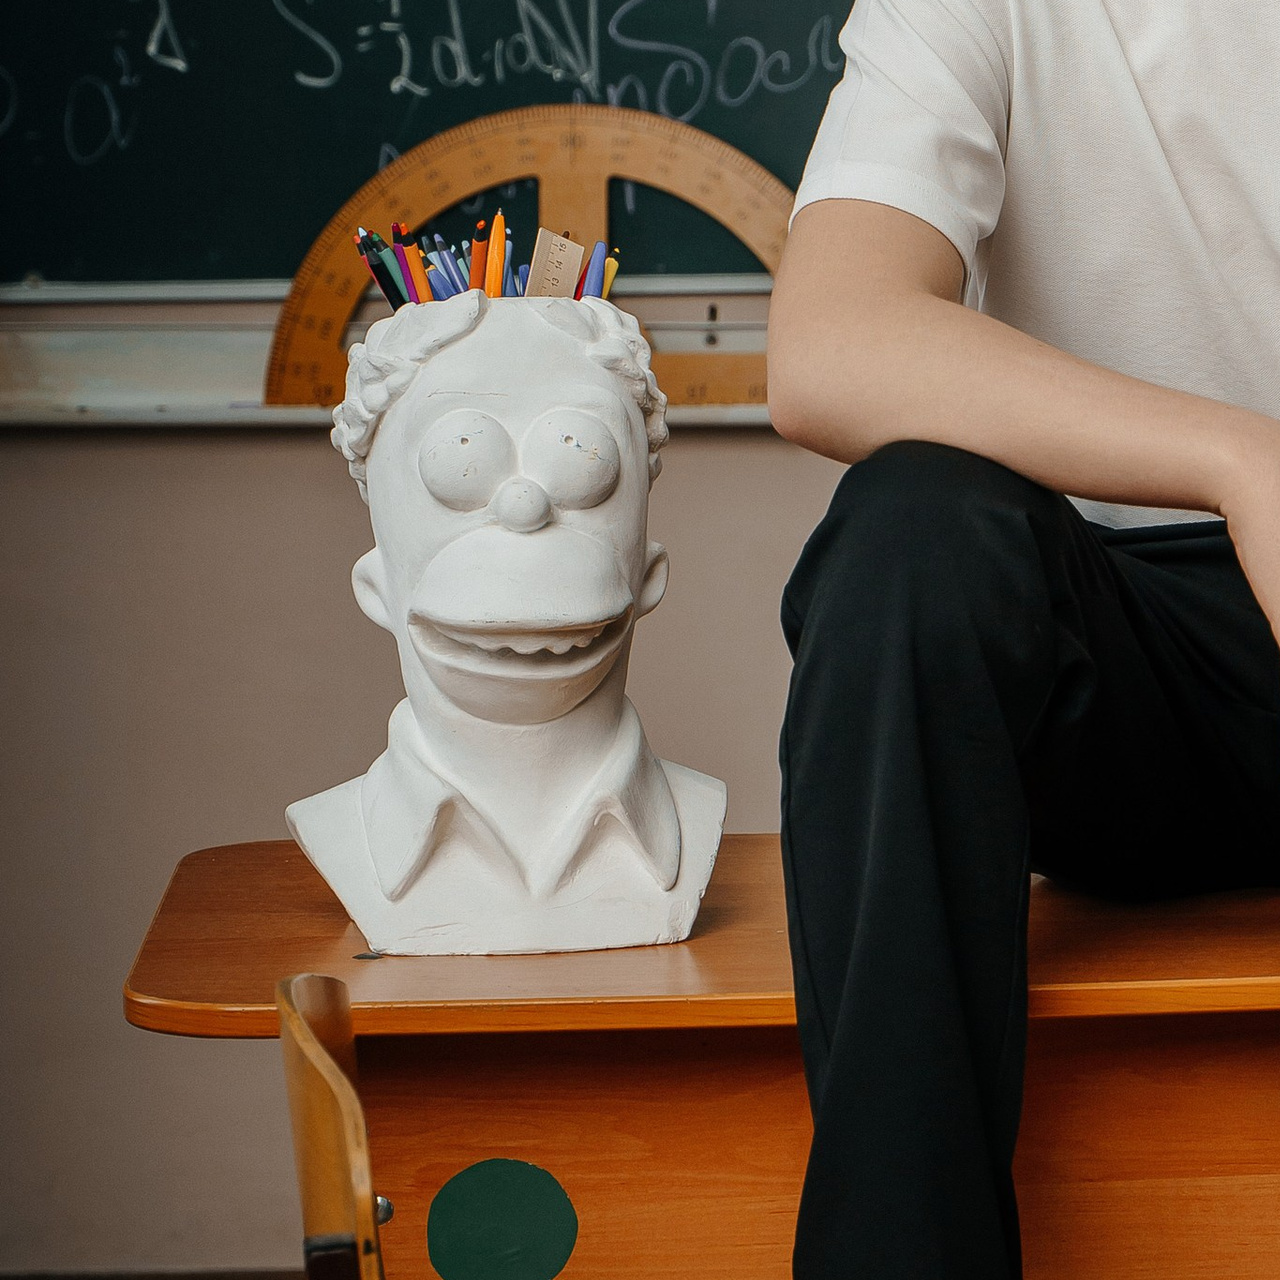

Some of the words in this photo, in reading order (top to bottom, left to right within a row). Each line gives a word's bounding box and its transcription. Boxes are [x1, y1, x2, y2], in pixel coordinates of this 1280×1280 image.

[559, 242, 567, 253] 15
[555, 260, 563, 270] 14
[551, 277, 560, 287] 13
